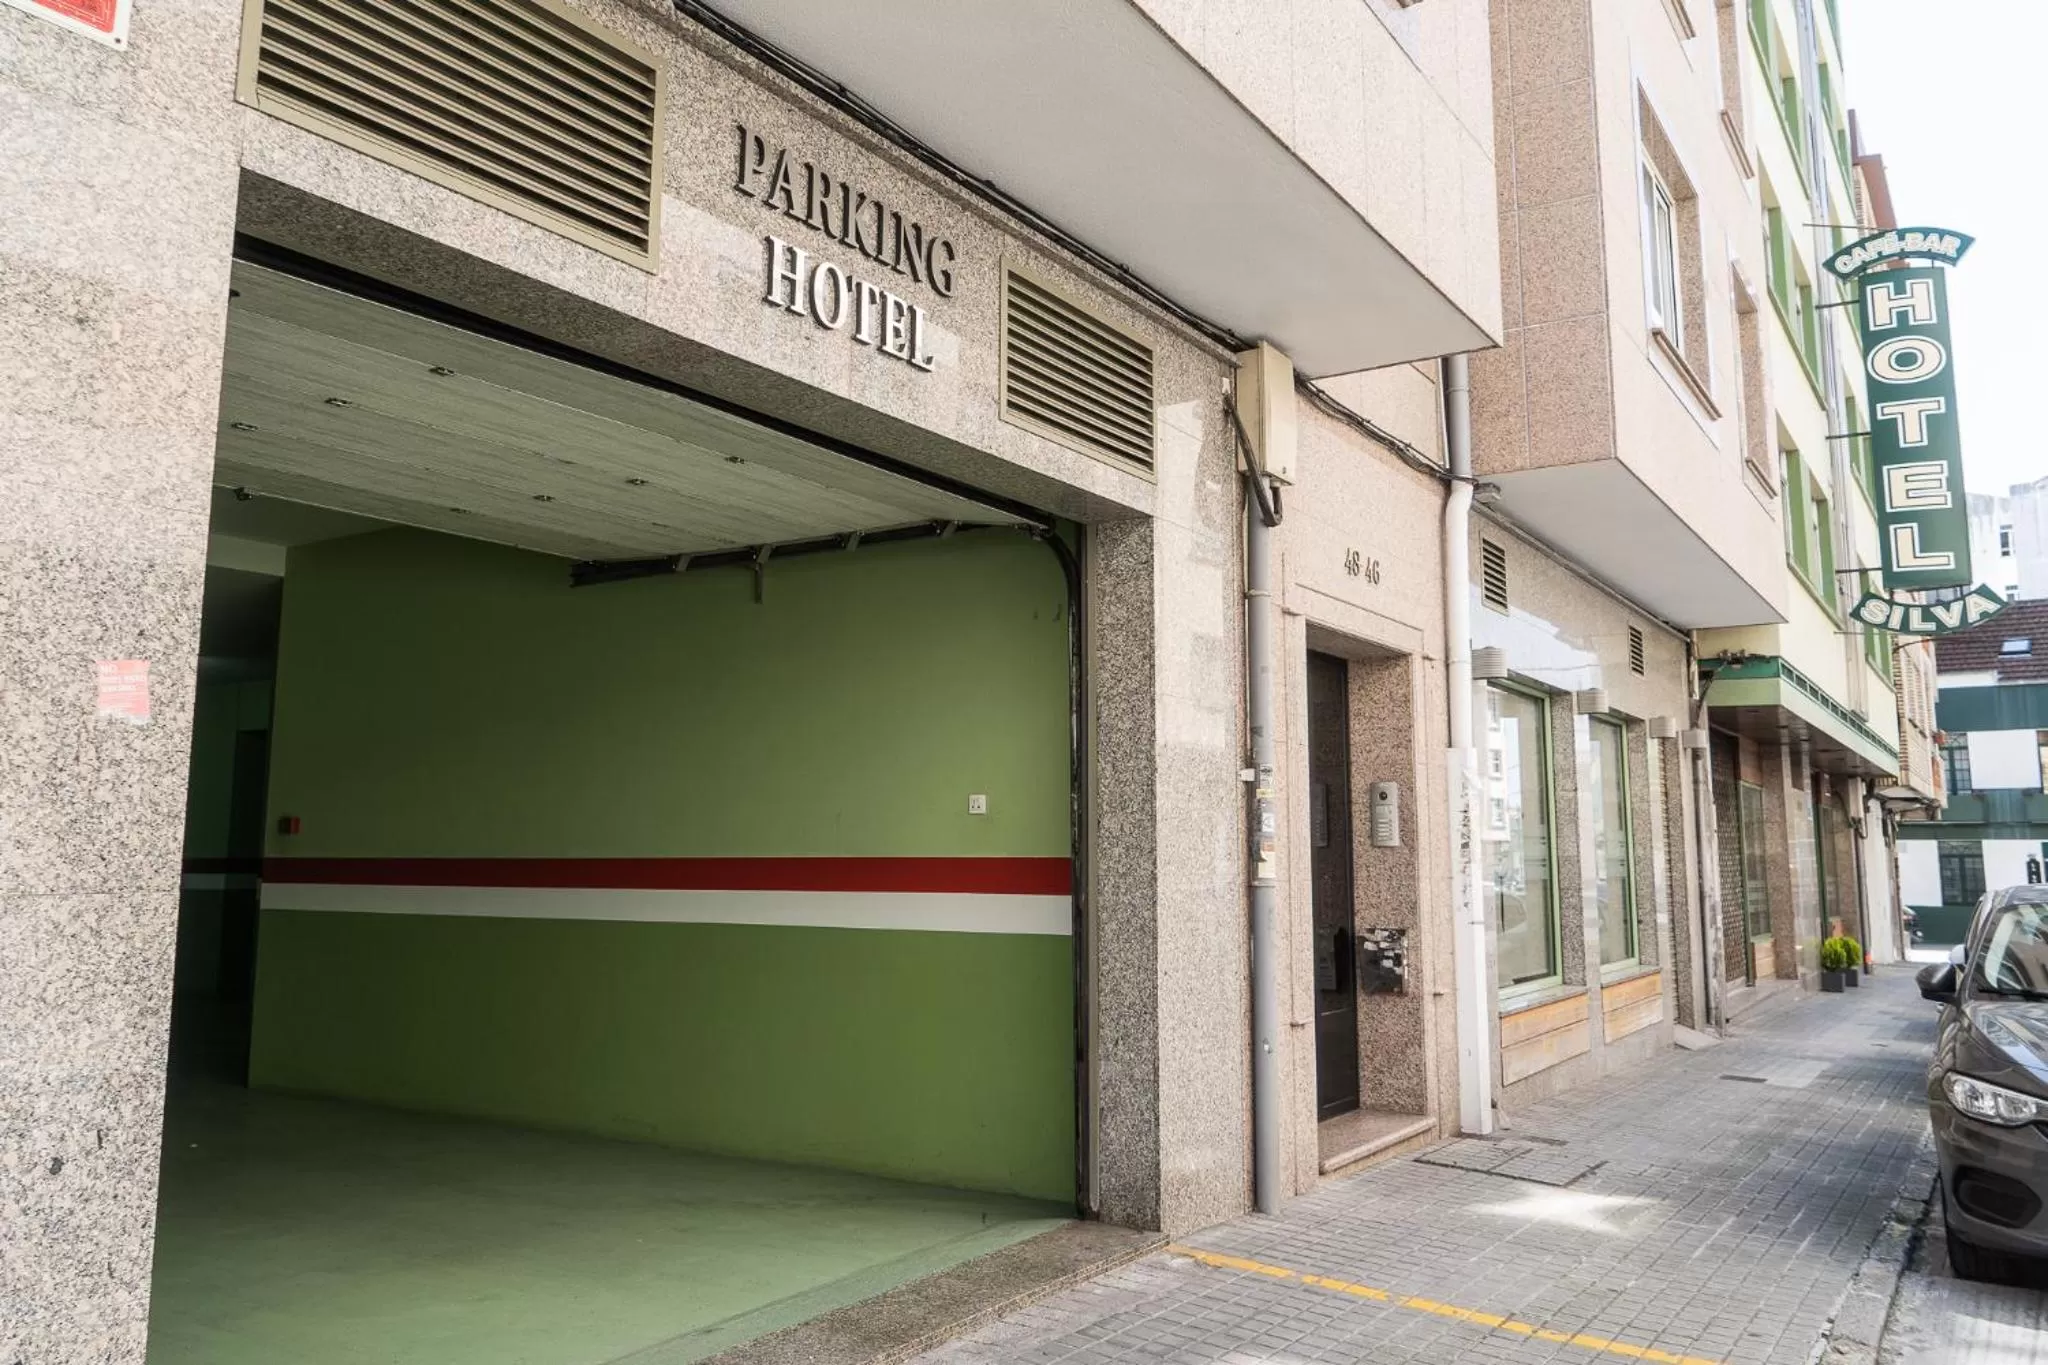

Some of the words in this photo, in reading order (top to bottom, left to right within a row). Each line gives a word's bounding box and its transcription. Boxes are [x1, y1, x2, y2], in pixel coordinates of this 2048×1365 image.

[734, 124, 956, 298] PARKING
[762, 235, 935, 372] HOTEL
[1866, 278, 1956, 573] HOTEL
[1859, 593, 2001, 632] SILVA
